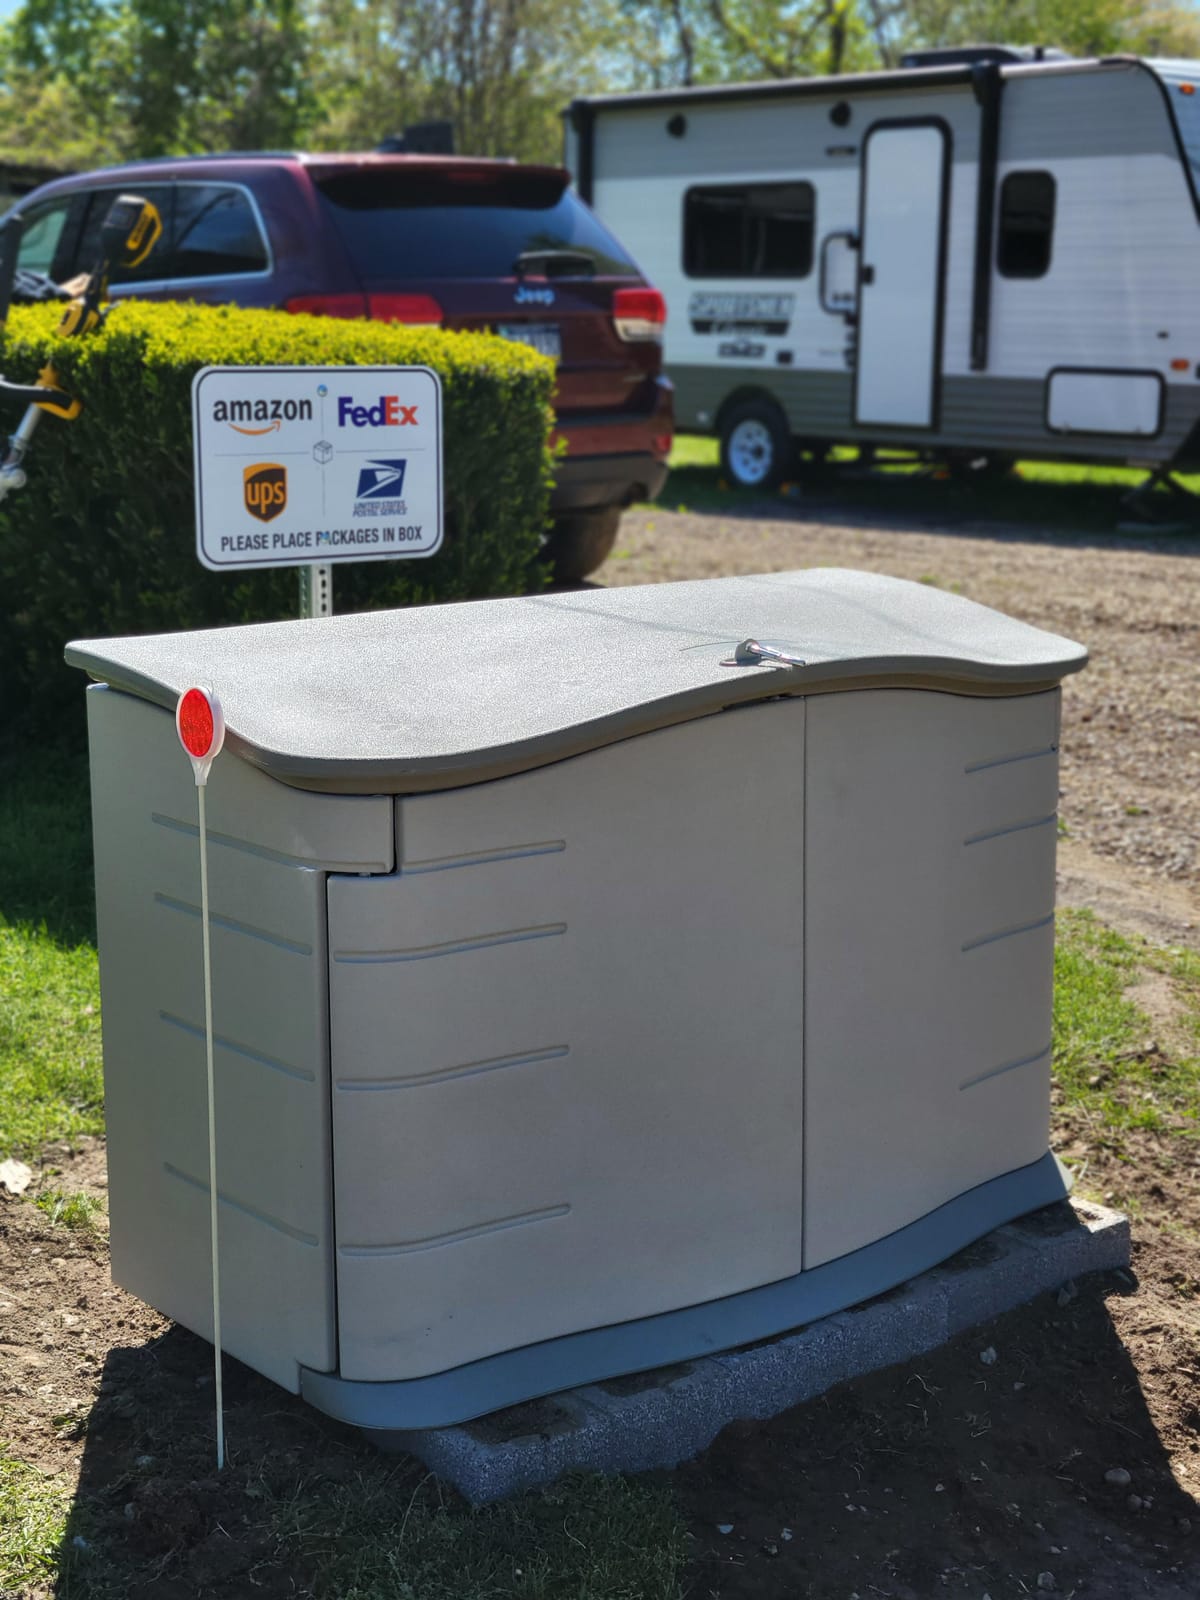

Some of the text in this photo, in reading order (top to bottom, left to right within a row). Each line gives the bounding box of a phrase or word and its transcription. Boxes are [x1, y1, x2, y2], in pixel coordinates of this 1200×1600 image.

[514, 286, 555, 305] Jeep
[213, 398, 313, 421] amazon
[338, 396, 418, 427] FedEx
[246, 481, 284, 514] ups
[221, 534, 271, 552] PLEASE
[273, 532, 312, 549] PLACE
[383, 527, 395, 542] IN
[398, 525, 422, 541] BOX
